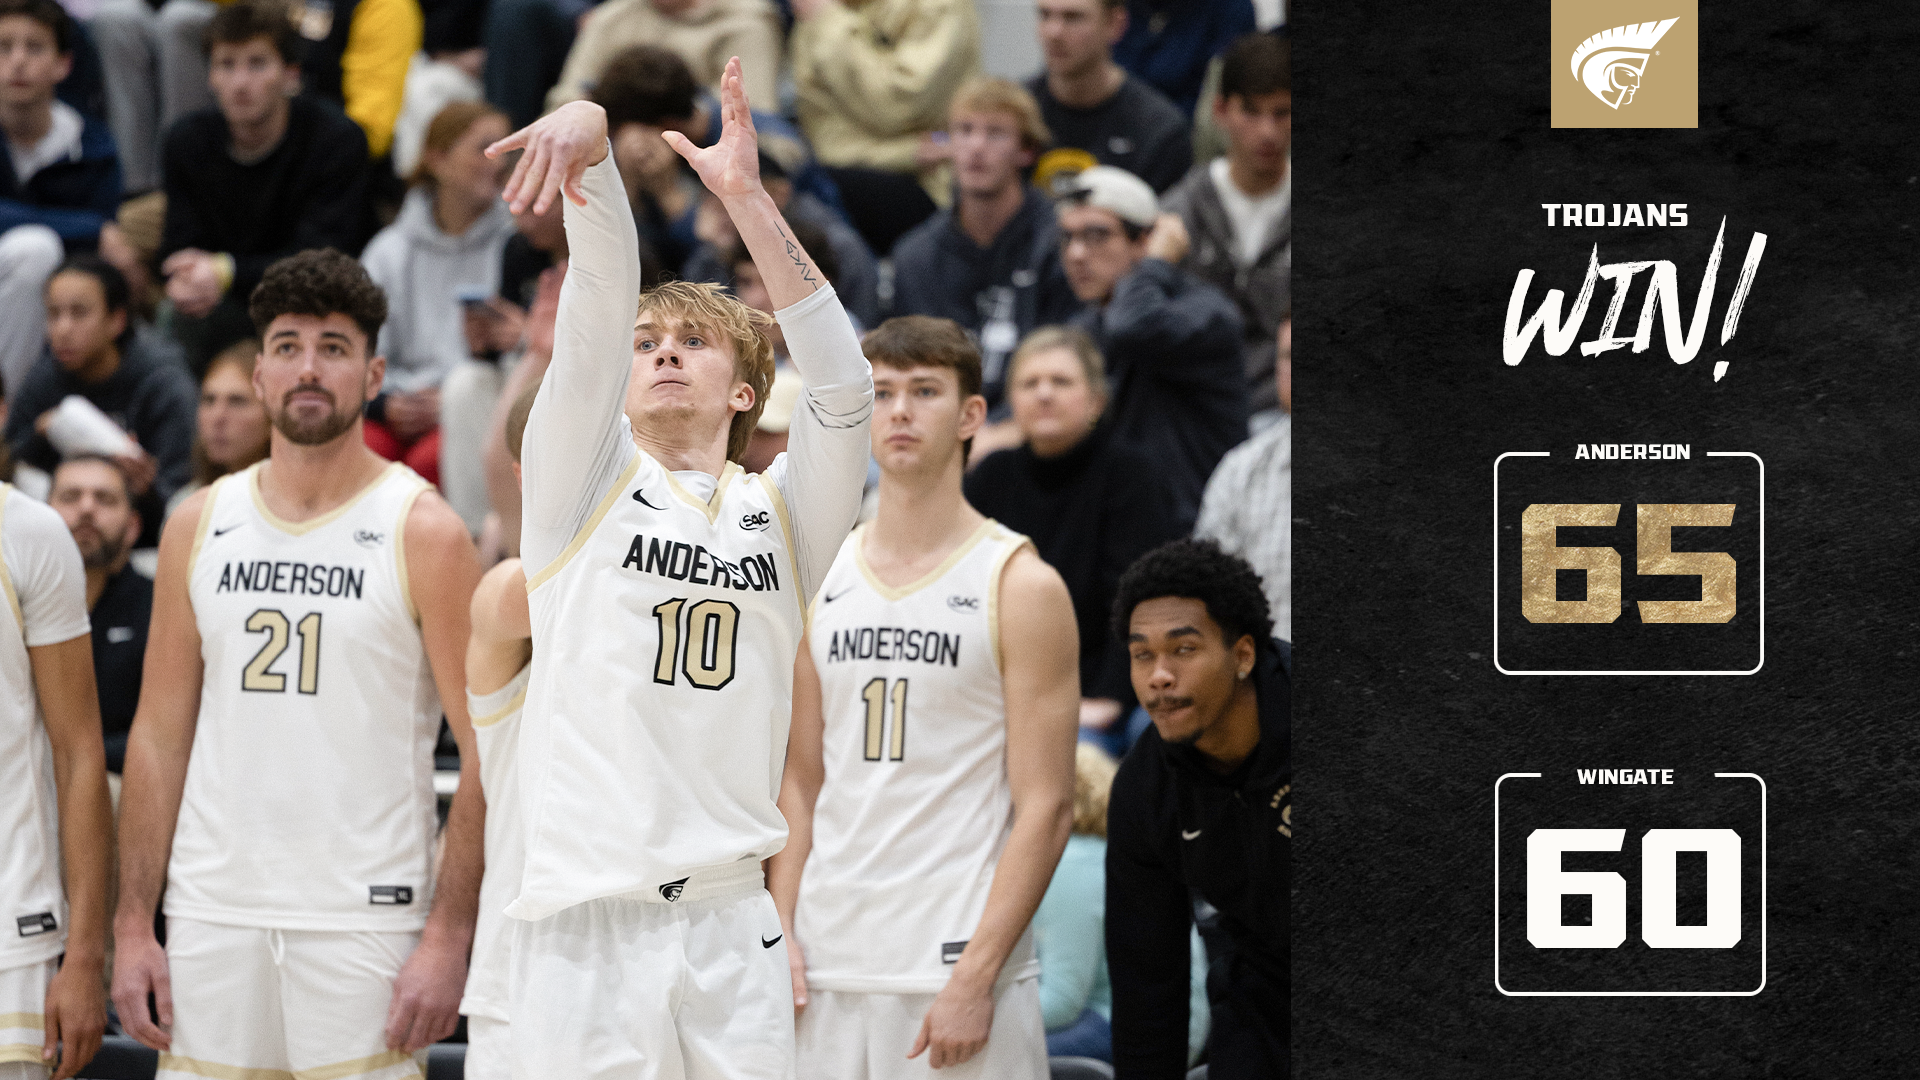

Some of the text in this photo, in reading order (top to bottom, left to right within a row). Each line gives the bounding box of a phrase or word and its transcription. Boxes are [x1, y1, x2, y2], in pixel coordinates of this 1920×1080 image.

[742, 511, 769, 527] SAC
[216, 561, 364, 600] ANDERSON
[622, 534, 779, 591] ANDERSON
[242, 608, 322, 695] 21
[652, 597, 740, 691] 10
[828, 627, 960, 668] ANDERSON
[862, 677, 908, 762] 11
